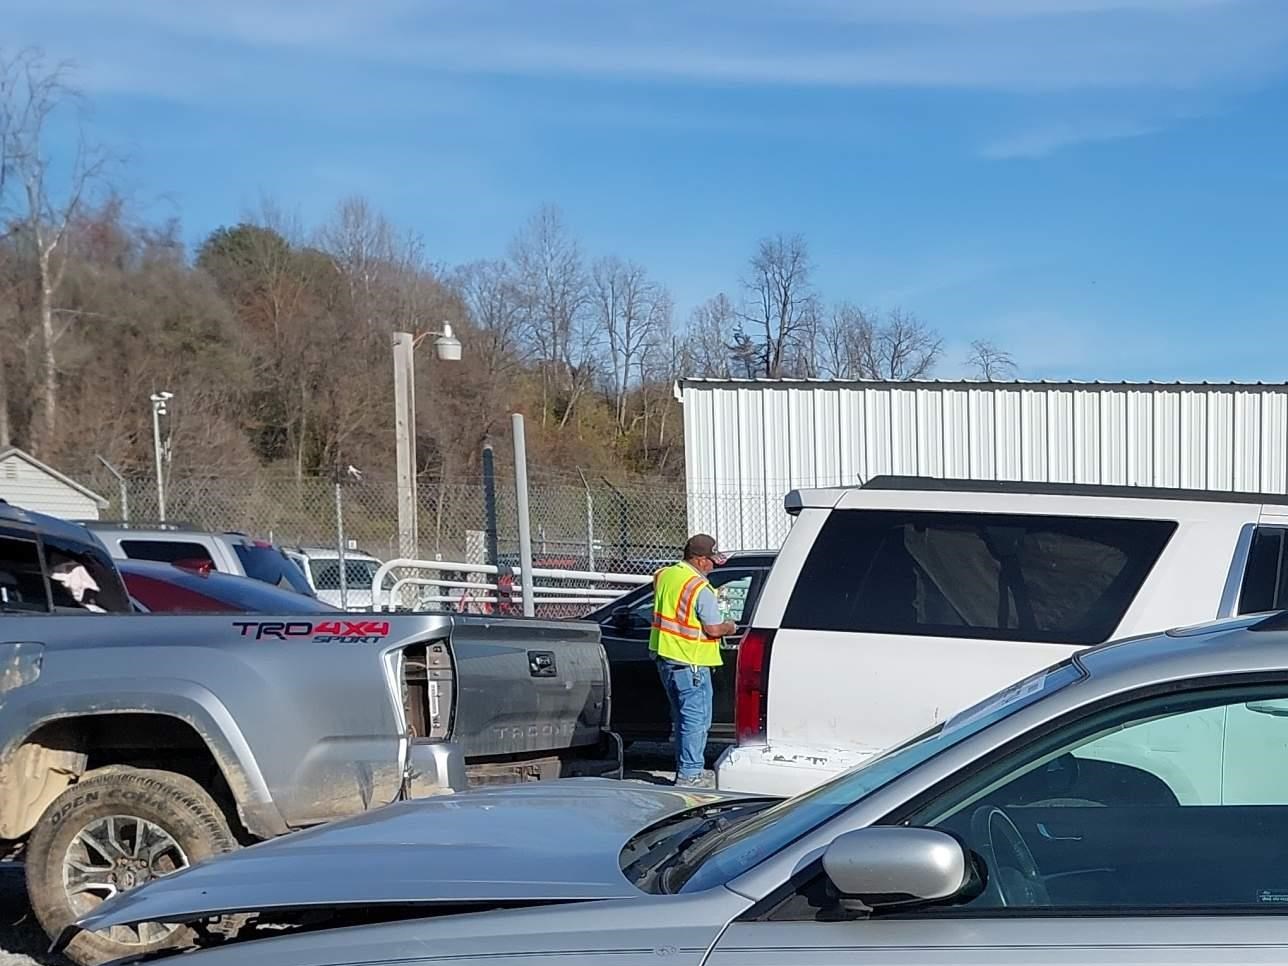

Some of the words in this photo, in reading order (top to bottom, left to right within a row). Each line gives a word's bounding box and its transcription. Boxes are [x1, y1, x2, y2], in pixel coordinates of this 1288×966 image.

[232, 621, 313, 641] TRD
[312, 635, 385, 644] SPORT
[51, 791, 100, 826] OPEN
